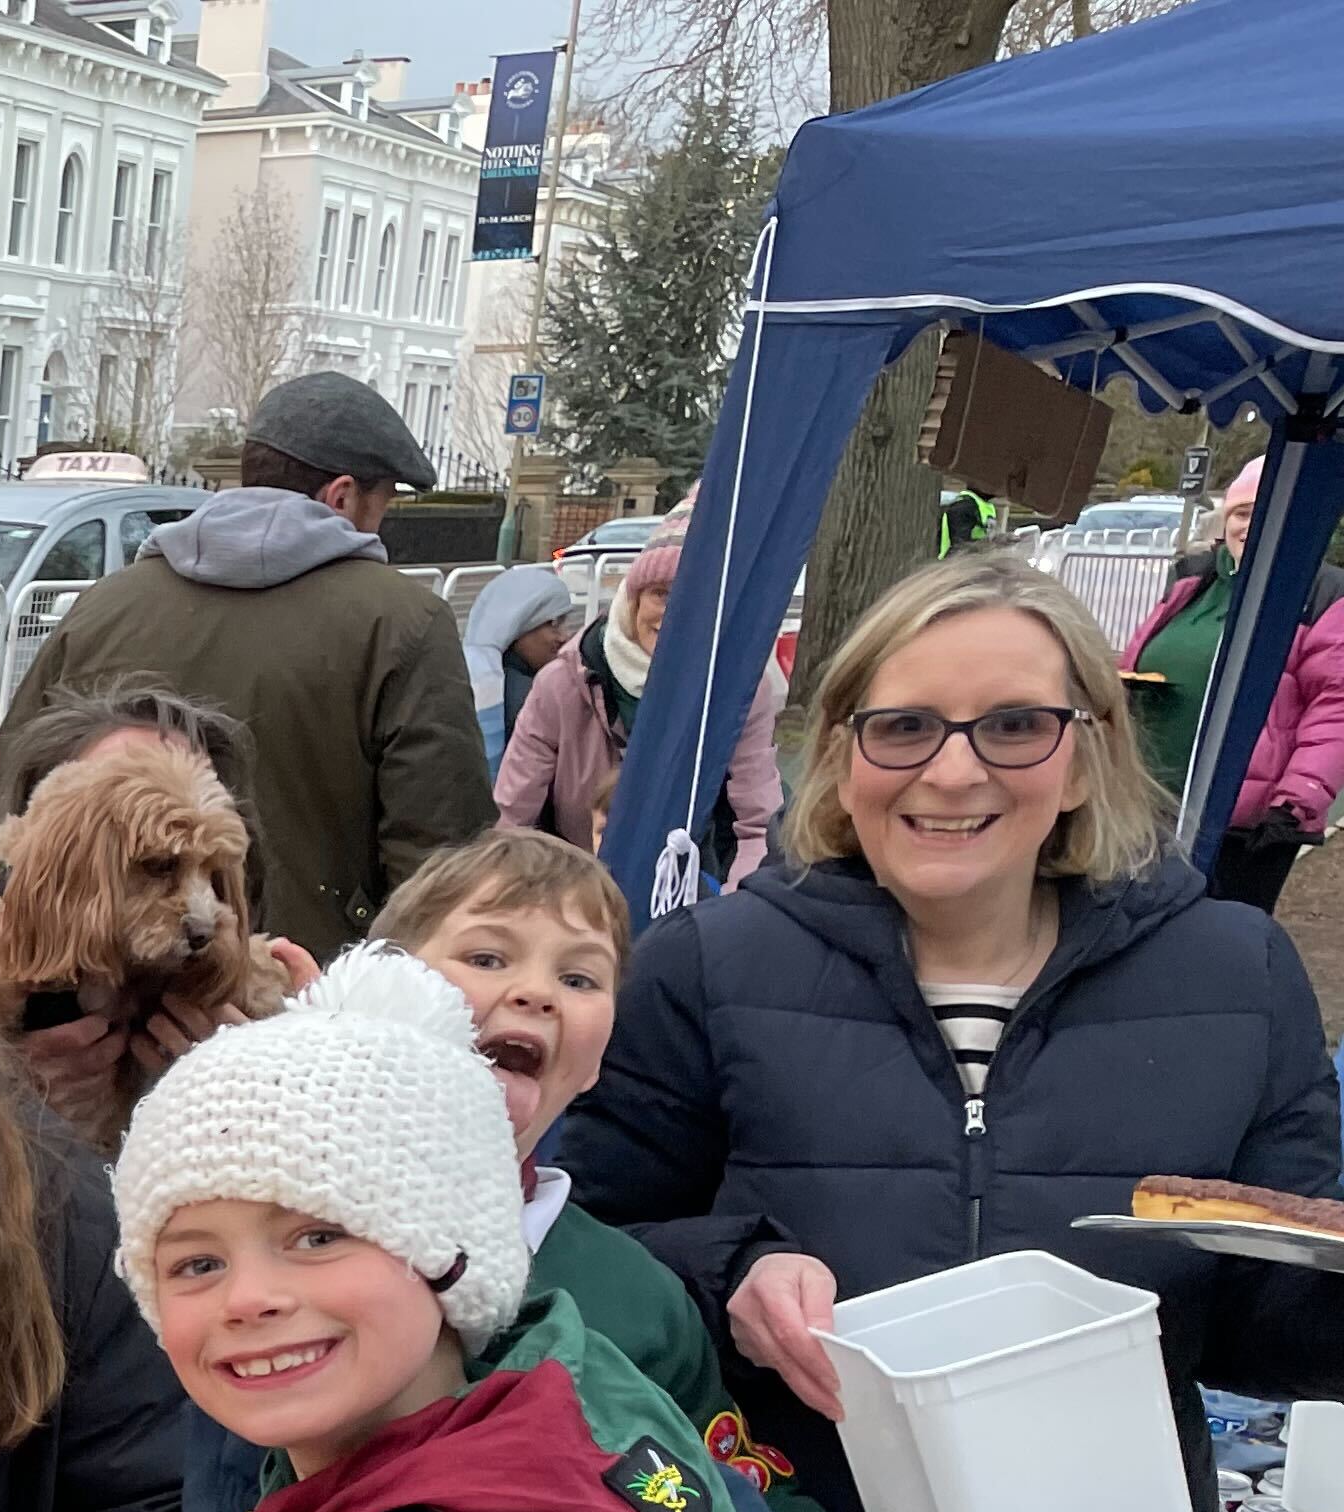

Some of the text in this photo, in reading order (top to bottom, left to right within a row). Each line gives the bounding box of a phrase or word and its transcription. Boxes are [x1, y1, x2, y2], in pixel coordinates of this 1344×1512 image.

[485, 144, 541, 159] NOTHING
[500, 214, 532, 224] MARCH
[512, 411, 532, 423] 30
[57, 455, 111, 473] TAXI
